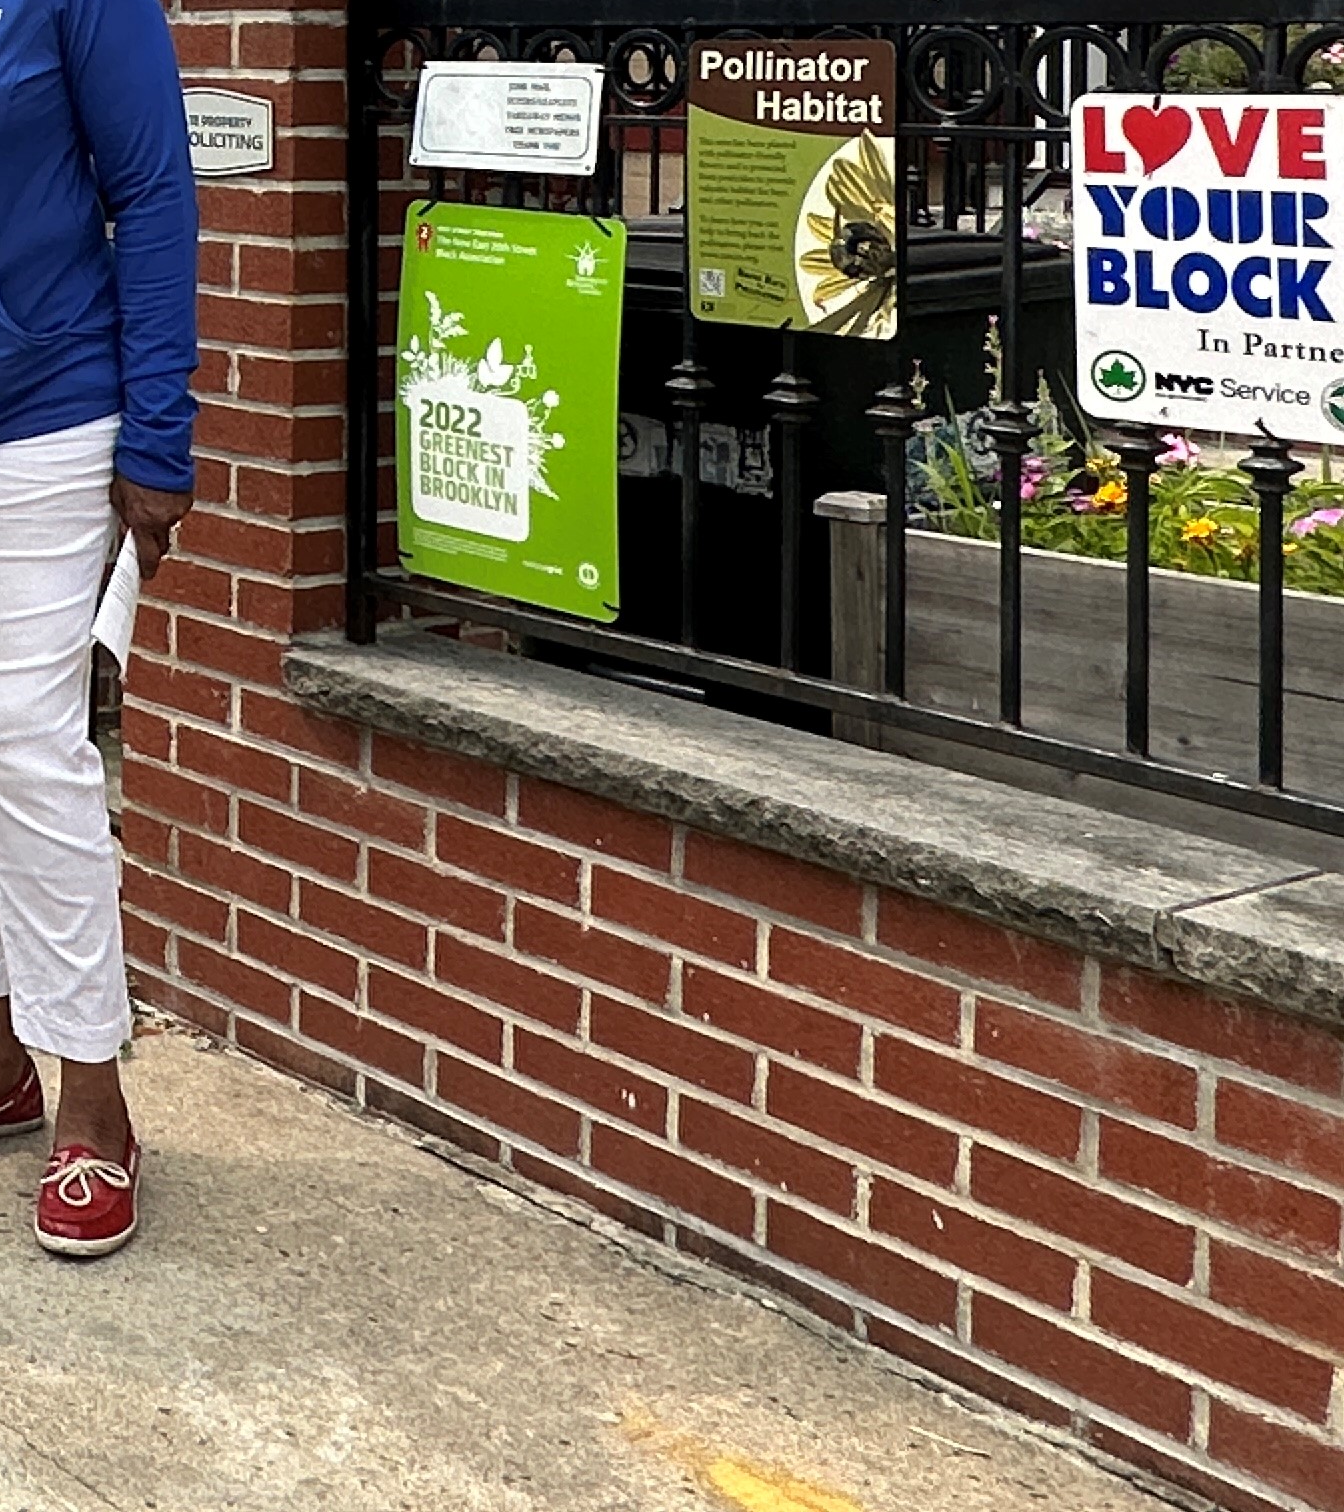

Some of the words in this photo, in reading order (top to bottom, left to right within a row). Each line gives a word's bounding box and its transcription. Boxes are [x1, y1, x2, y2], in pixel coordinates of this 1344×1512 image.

[700, 50, 869, 82] Pollinator
[756, 90, 883, 123] Habitat
[188, 131, 264, 150] OLICITING
[1084, 184, 1334, 249] YOUR
[1087, 247, 1335, 323] BLOCK
[1197, 328, 1231, 354] In
[1242, 332, 1344, 364] Partne
[1155, 372, 1214, 396] NYC
[1220, 377, 1311, 406] Service
[419, 398, 482, 438] 2022
[419, 430, 514, 468] GREENEST
[419, 452, 480, 484] BLOCK
[484, 464, 506, 490] IN
[420, 474, 518, 516] BROOKLYN
